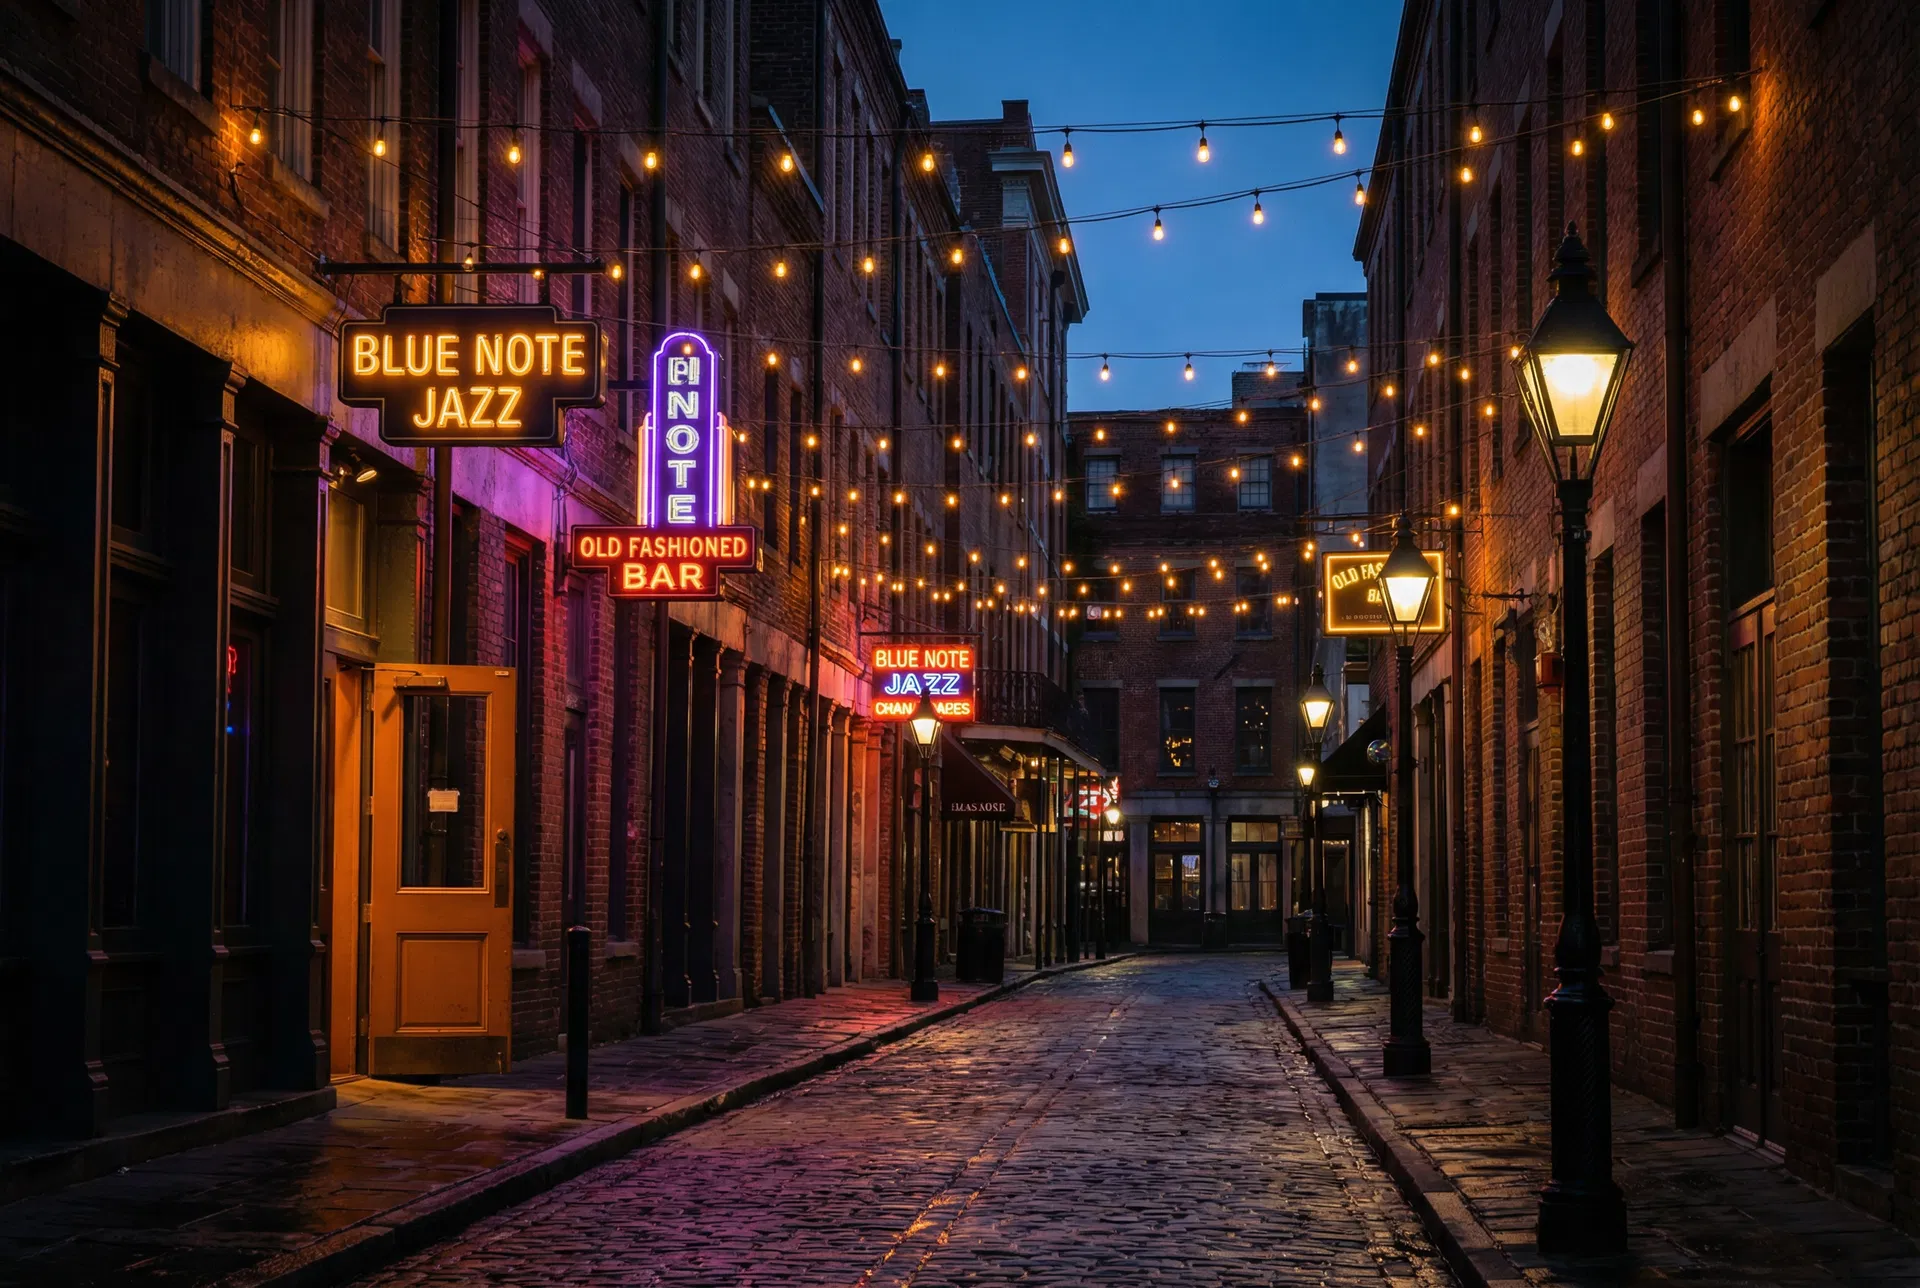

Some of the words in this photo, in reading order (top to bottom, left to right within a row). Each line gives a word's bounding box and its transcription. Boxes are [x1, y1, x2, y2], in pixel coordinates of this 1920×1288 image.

[353, 334, 459, 376] BLUE
[475, 334, 585, 376] NOTE
[413, 386, 522, 428] JAZZ
[580, 537, 621, 558] OLD
[630, 537, 746, 558] FASHIONED
[623, 563, 703, 589] BAR
[1331, 567, 1359, 590] OLD
[875, 650, 918, 668] BLUE
[925, 650, 969, 668] NOTE
[884, 673, 961, 695] JAZZ
